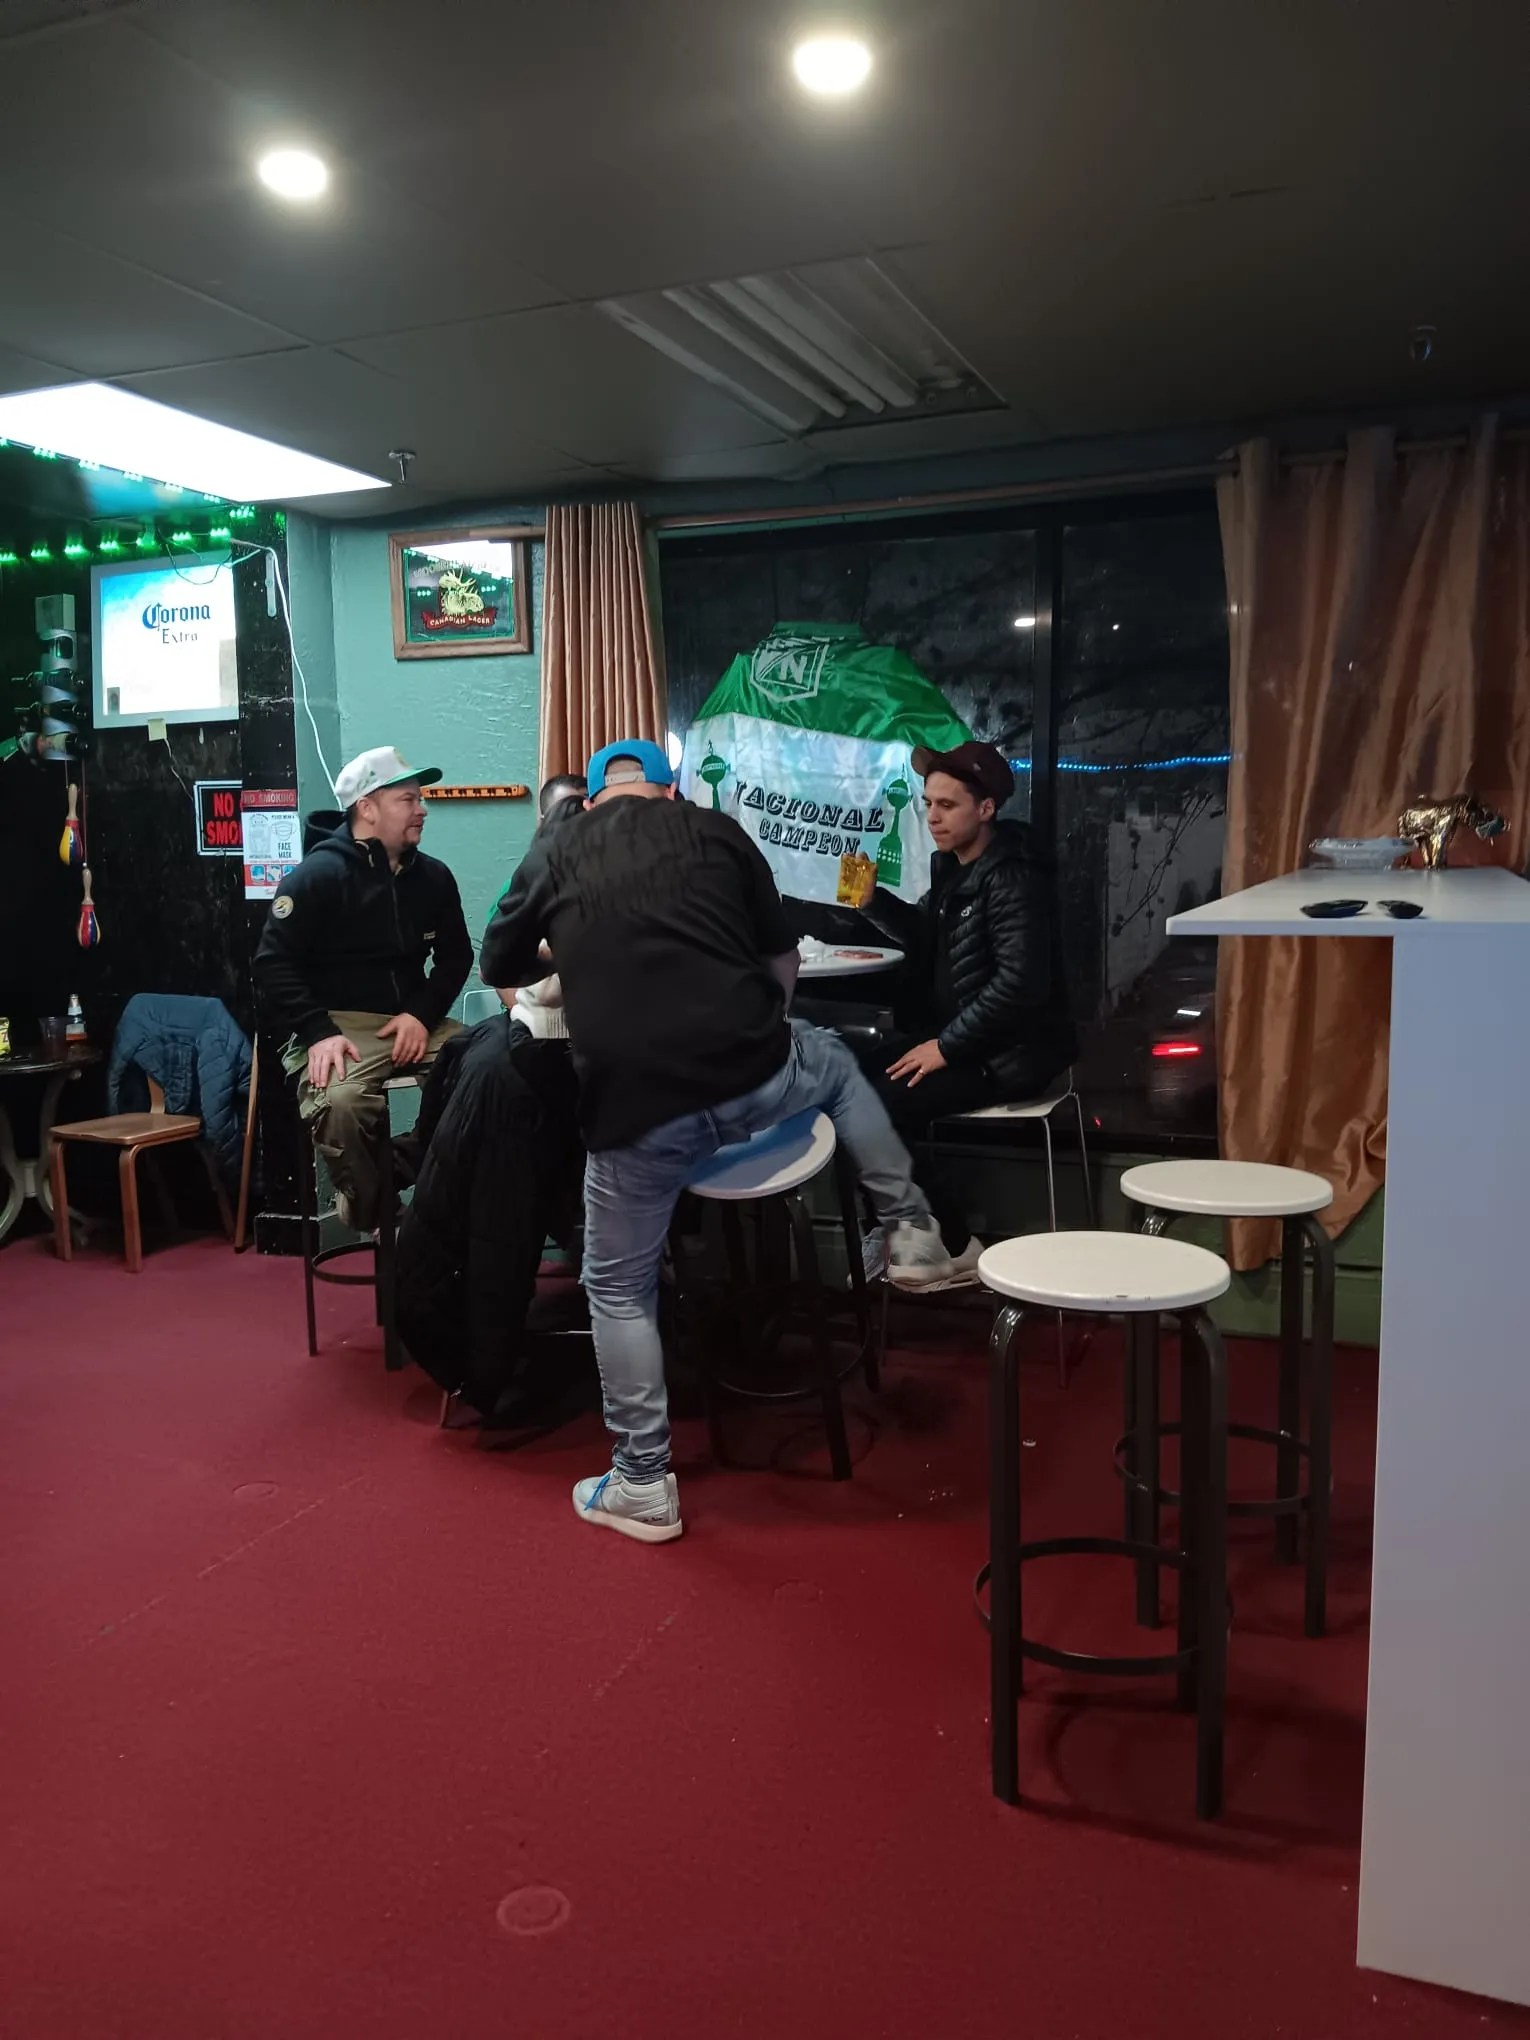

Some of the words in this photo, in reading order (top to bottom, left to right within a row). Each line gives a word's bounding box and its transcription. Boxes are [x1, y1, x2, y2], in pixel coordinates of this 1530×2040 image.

[142, 602, 211, 631] Corona
[430, 615, 466, 627] CANADIAN
[468, 615, 490, 625] LAGER
[162, 628, 198, 644] Extra
[213, 792, 234, 817] NO
[258, 792, 294, 804] SMOKING
[759, 818, 860, 857] CAMPEON
[278, 842, 292, 851] FACE
[278, 851, 293, 859] MASK
